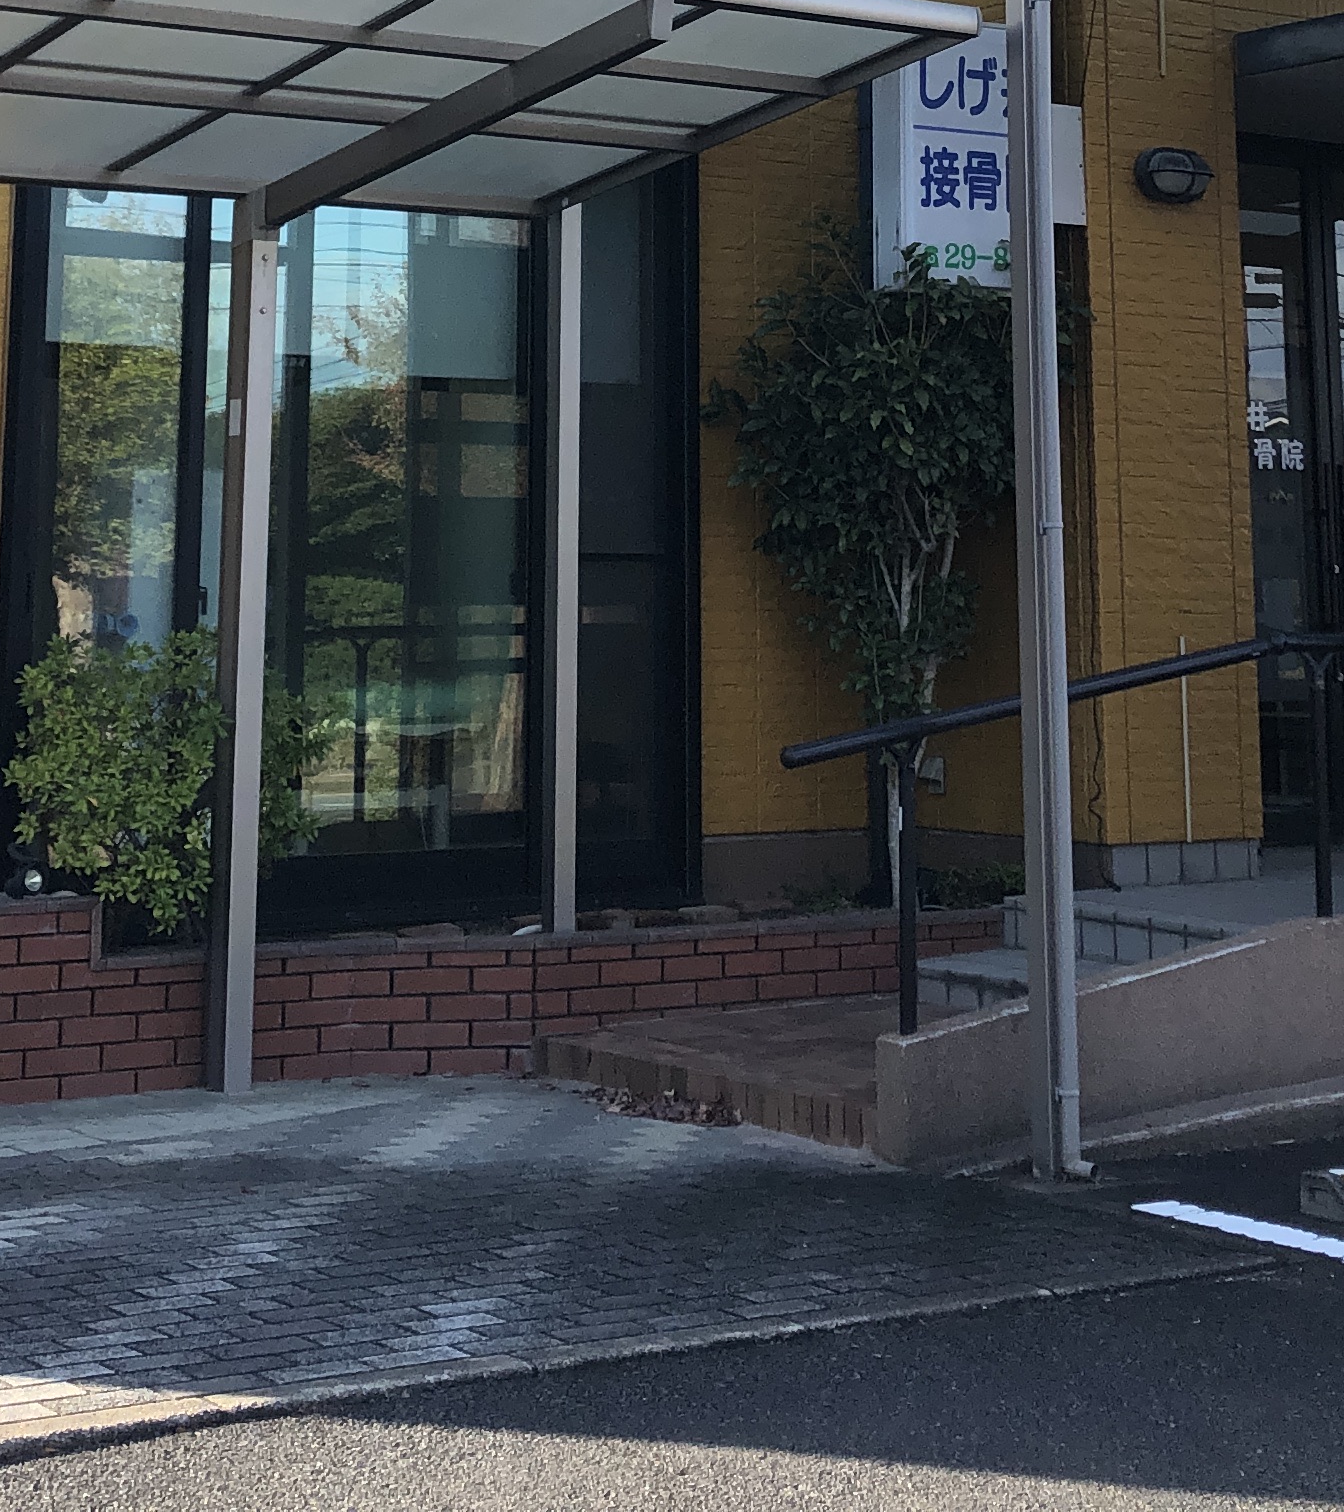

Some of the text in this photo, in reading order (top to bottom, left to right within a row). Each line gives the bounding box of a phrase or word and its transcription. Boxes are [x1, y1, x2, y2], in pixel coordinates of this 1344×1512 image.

[919, 56, 1008, 117] しげ
[920, 145, 1010, 212] 接骨
[1254, 439, 1305, 471] 骨院
